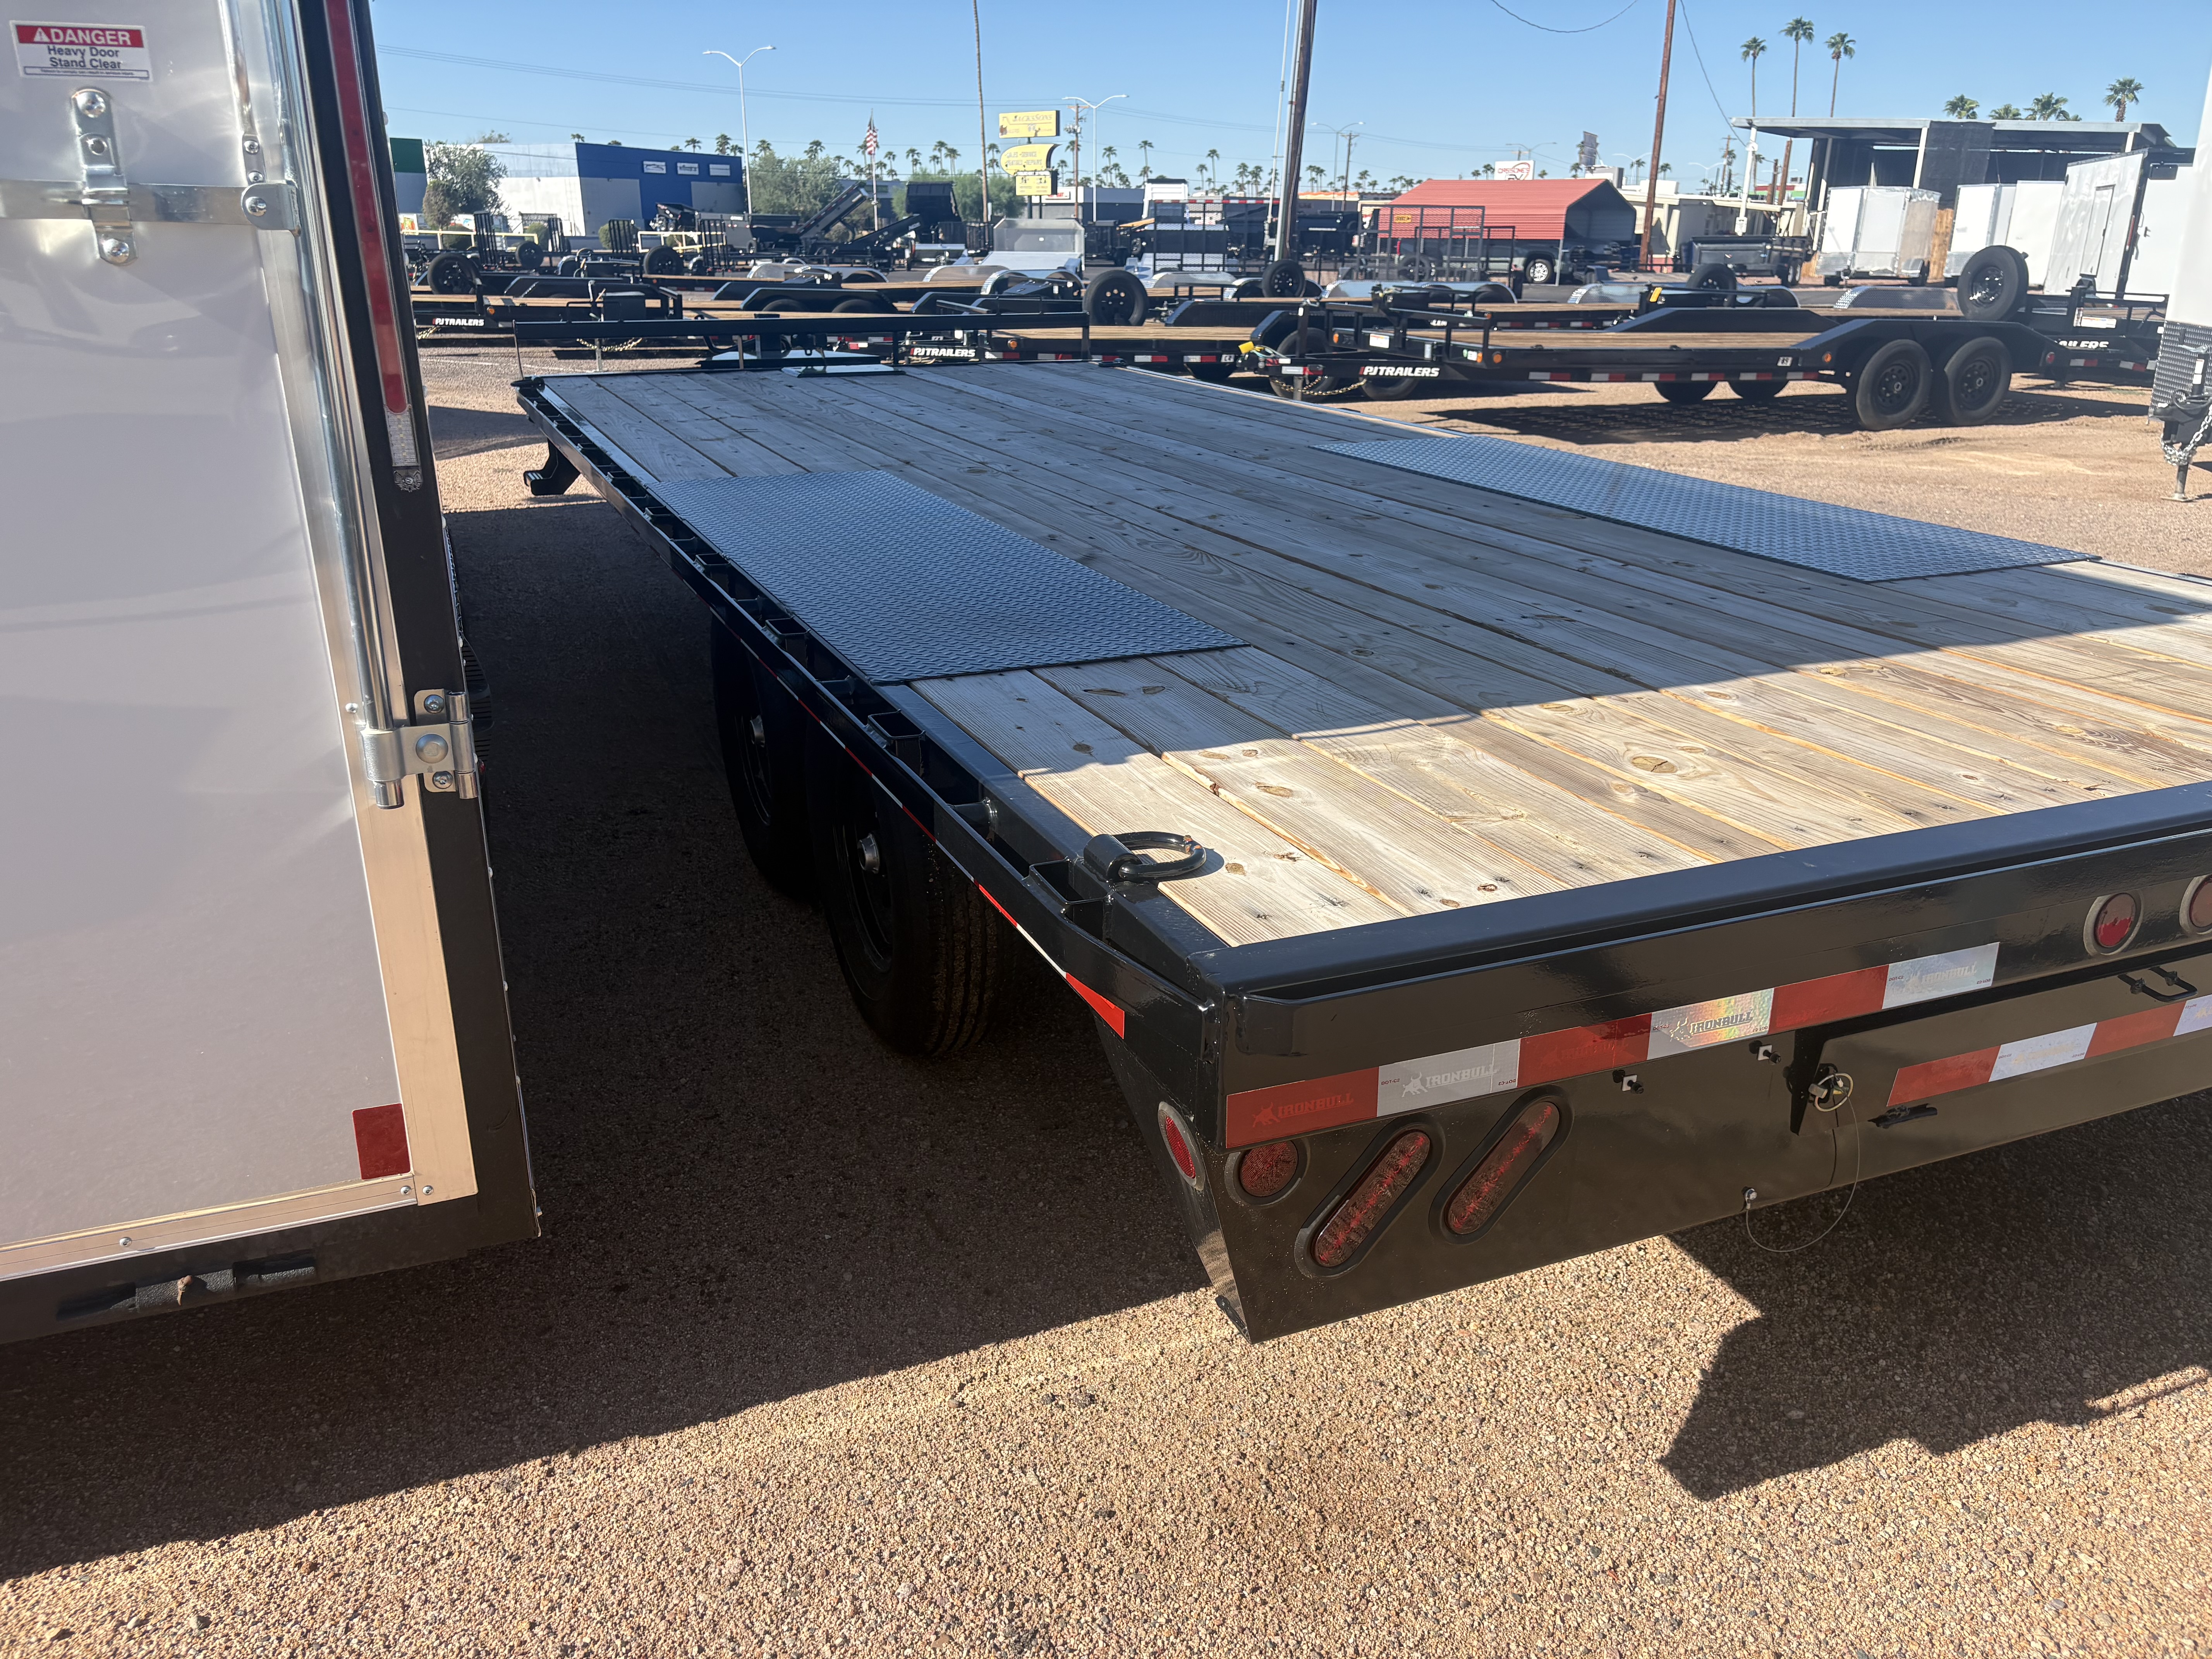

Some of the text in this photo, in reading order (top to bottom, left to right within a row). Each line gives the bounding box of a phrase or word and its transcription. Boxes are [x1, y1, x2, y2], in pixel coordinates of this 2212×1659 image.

[50, 28, 131, 45] DANGER
[47, 45, 119, 58] Heavy Door
[50, 57, 122, 69] Stand Clear
[926, 348, 975, 357] TRAILERS
[1363, 366, 1440, 377] PJ TRAILERS
[1690, 1008, 1753, 1034] IRONBULL
[1425, 1063, 1499, 1087] IRONBULL
[1278, 1092, 1354, 1118] IRONBULL
